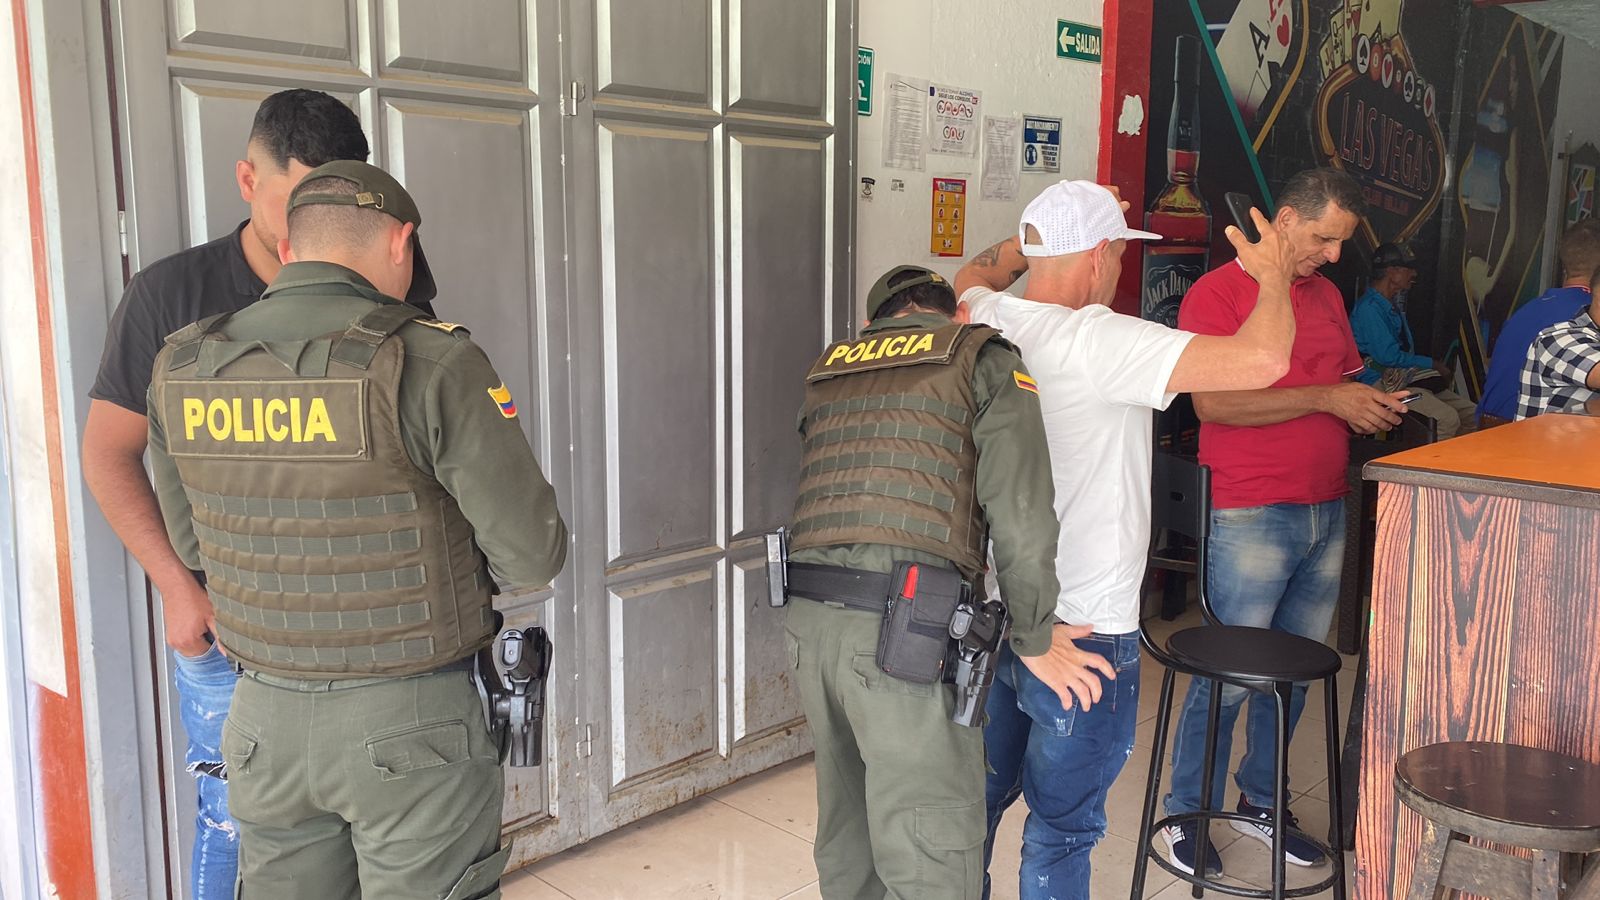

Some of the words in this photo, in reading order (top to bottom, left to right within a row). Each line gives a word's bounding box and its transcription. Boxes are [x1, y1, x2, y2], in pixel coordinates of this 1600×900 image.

[1075, 32, 1100, 55] SALIDA
[1249, 21, 1270, 69] A
[1340, 92, 1377, 170] LAS
[1381, 113, 1433, 191] VEGAS
[1146, 278, 1169, 313] JACK
[825, 333, 935, 366] POLICIA
[183, 397, 337, 442] POLICIA
